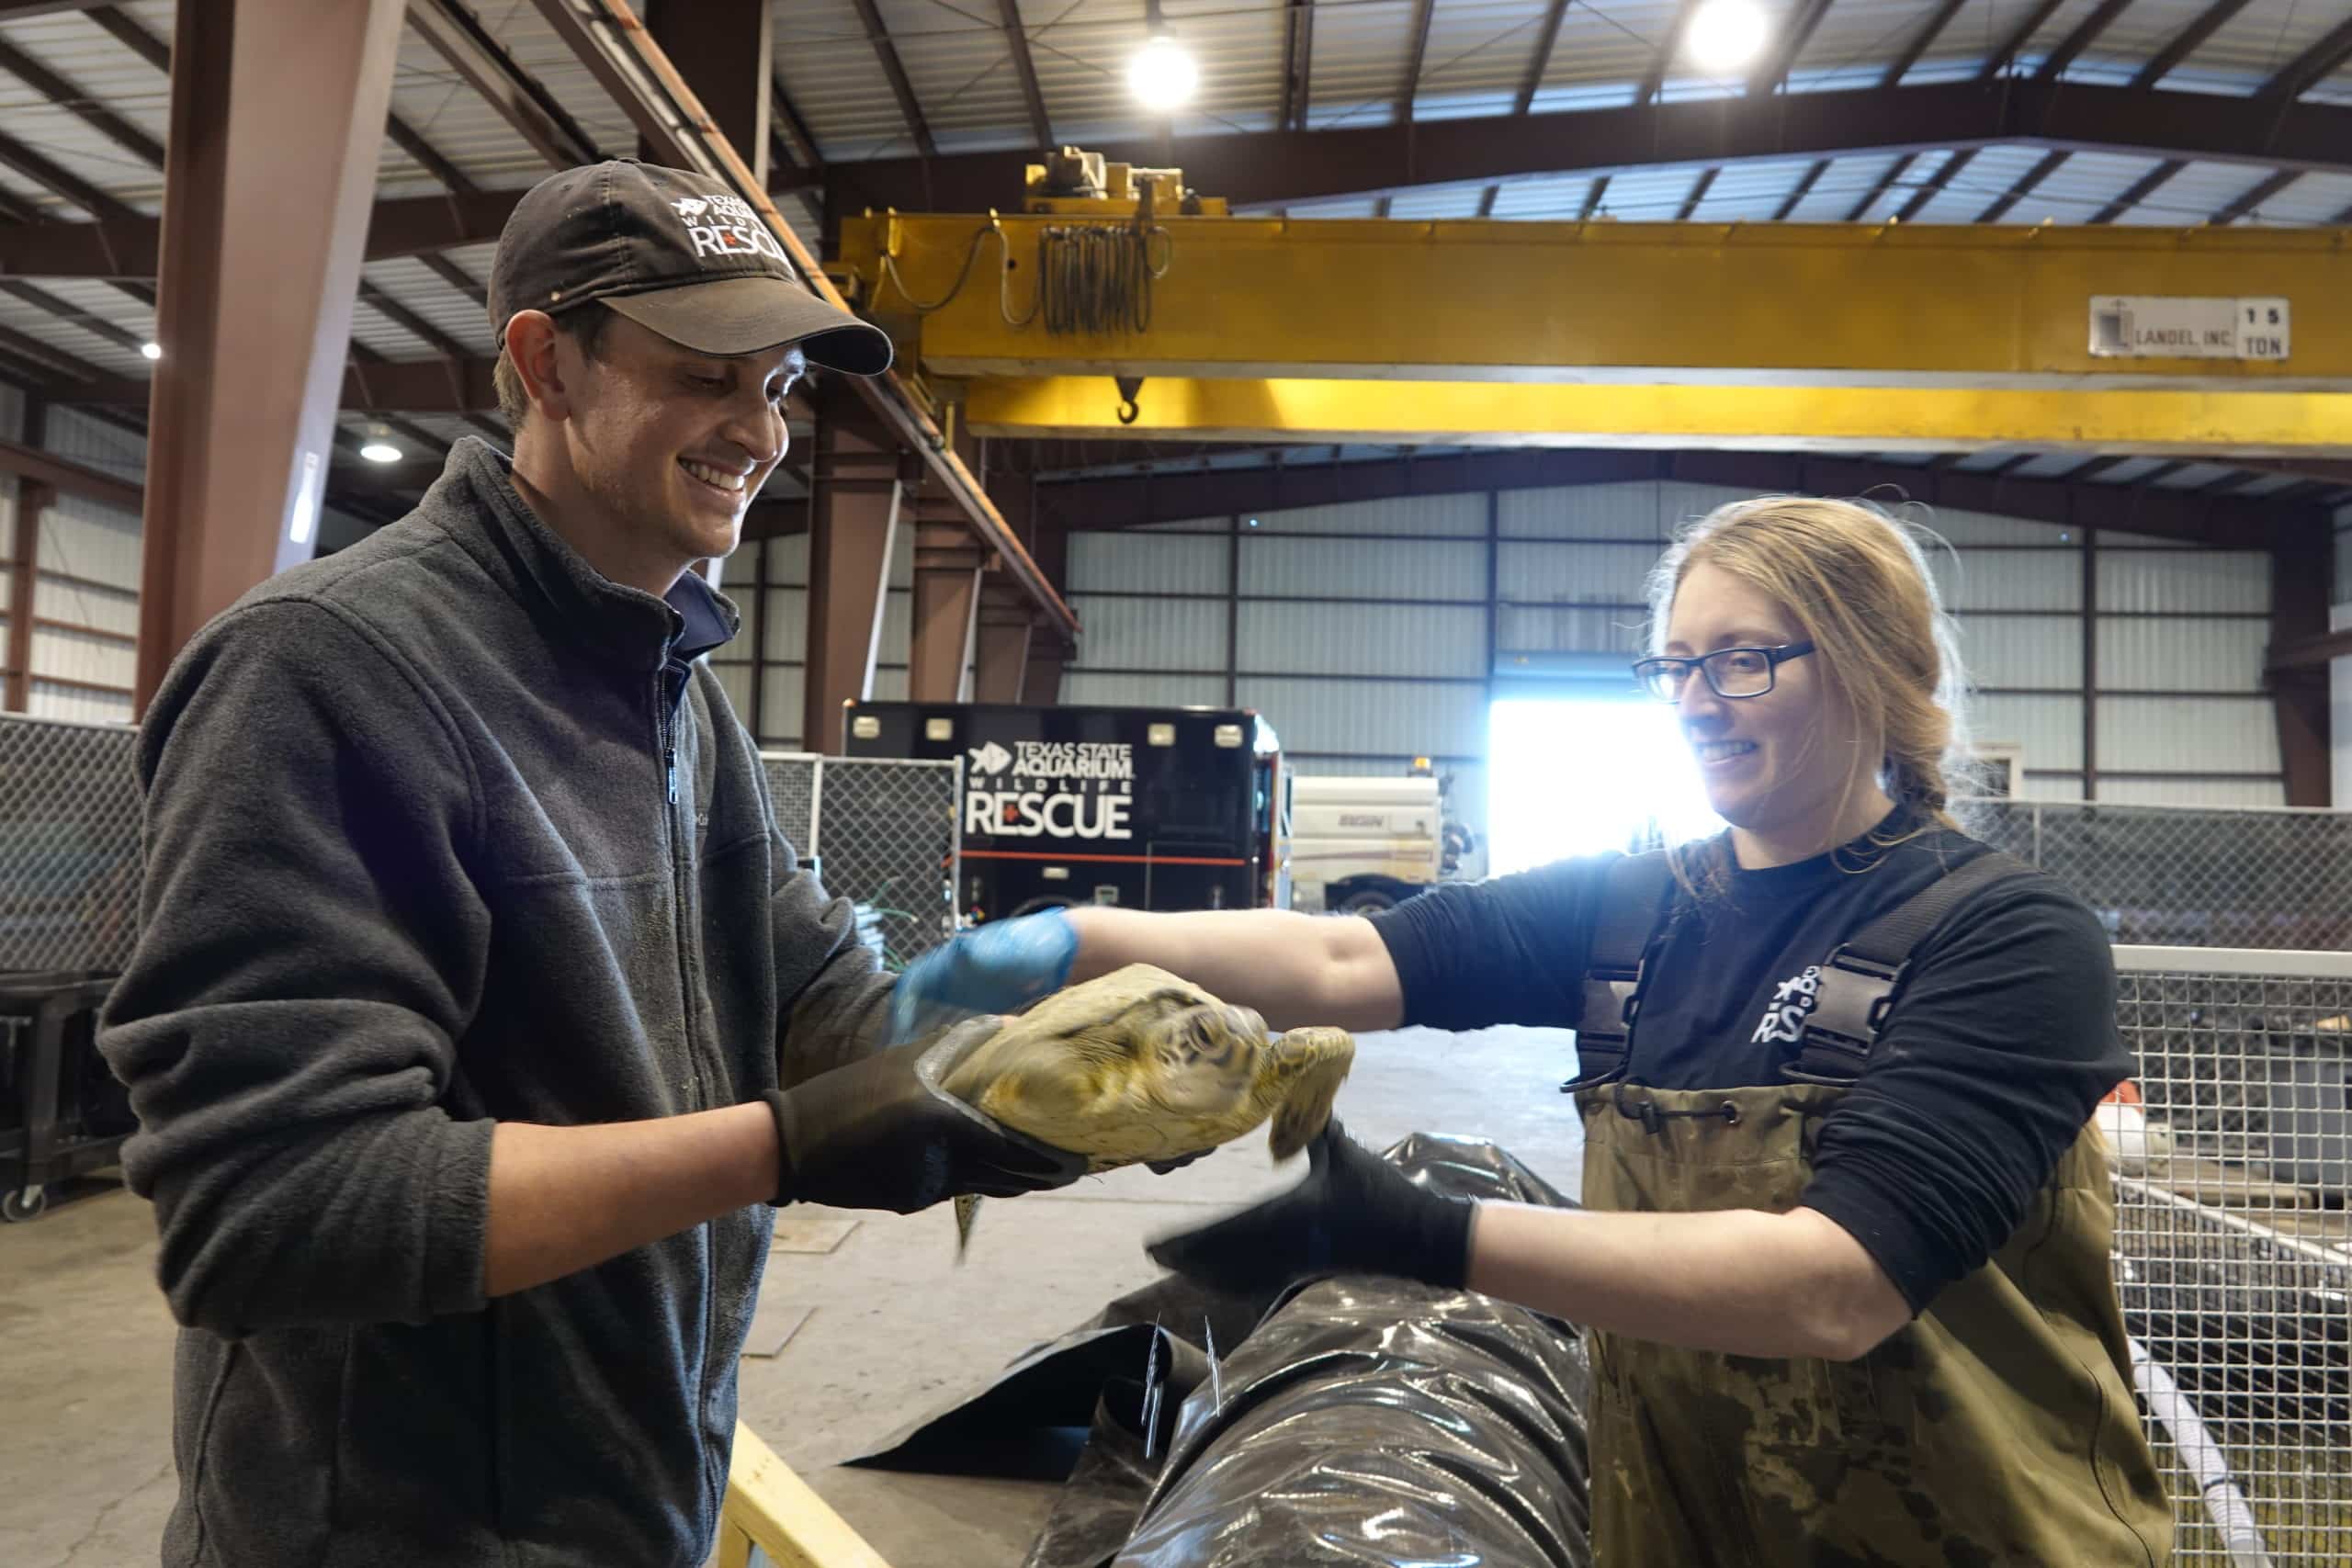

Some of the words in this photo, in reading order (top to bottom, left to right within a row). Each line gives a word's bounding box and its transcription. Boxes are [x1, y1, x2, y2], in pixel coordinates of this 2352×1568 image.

[2245, 336, 2282, 355] TON
[1013, 740, 1075, 758] TEXAS
[1076, 742, 1132, 760] STATE
[1012, 759, 1133, 779] AQUARIUM
[968, 777, 1132, 794] WILDLIFE
[966, 792, 1132, 839] RESCUE
